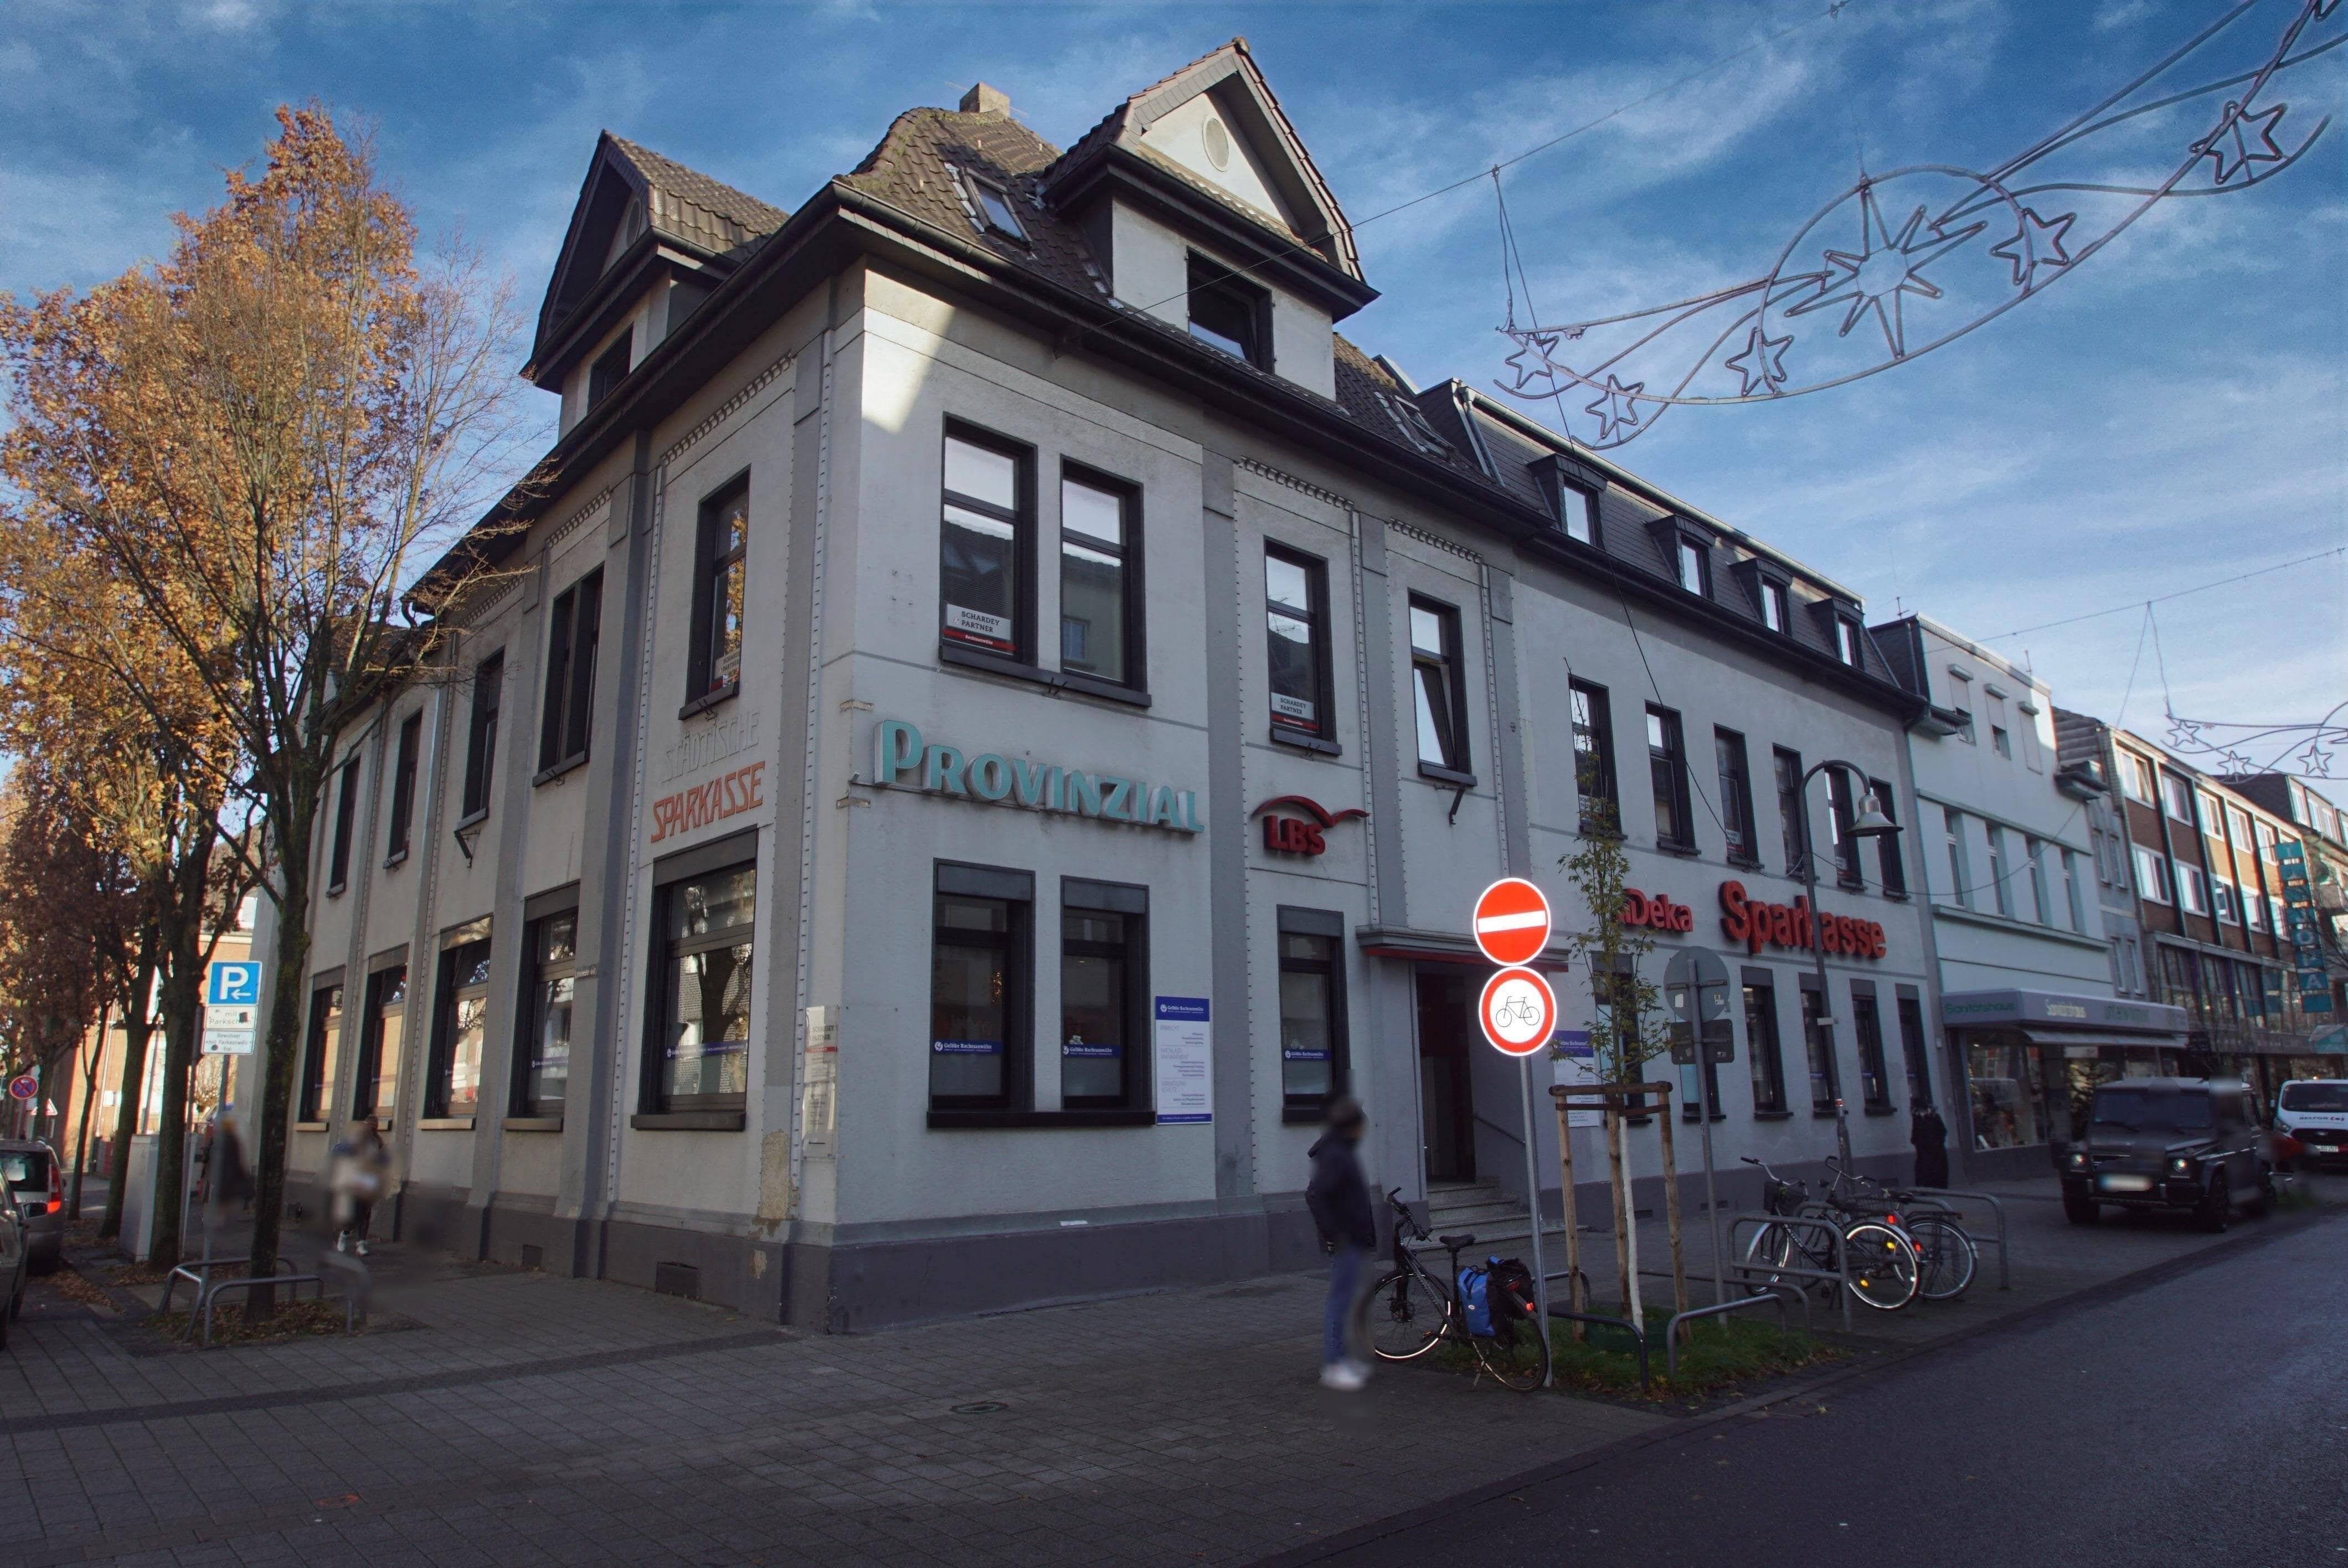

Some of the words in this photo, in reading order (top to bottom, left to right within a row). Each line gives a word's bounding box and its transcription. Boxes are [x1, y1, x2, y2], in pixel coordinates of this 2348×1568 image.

[961, 611, 1000, 626] SCHARDEY
[962, 620, 993, 632] PARTNER
[651, 761, 765, 843] SPARKASSE
[1264, 815, 1326, 855] LBS
[1623, 888, 1693, 932] Deka
[219, 966, 249, 1000] P
